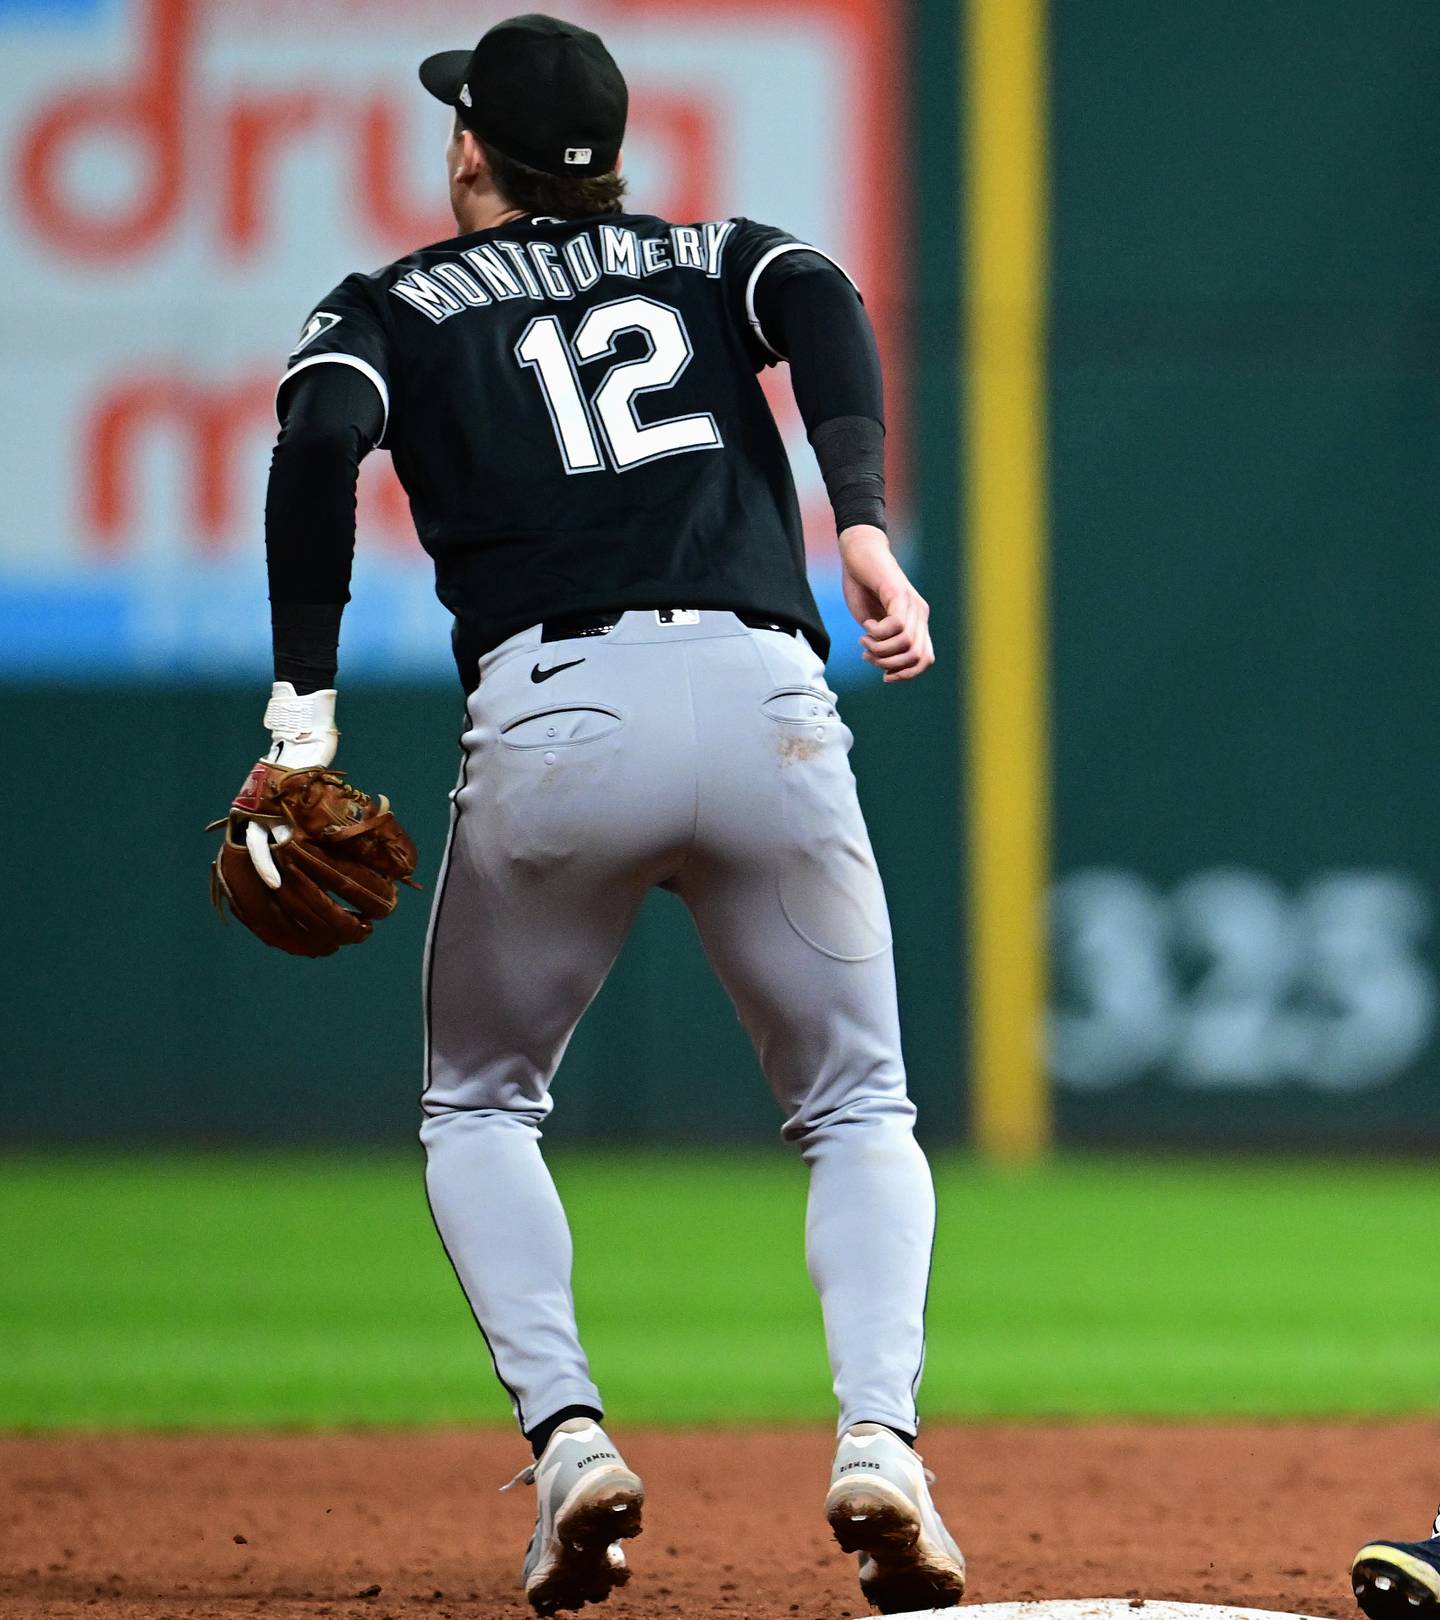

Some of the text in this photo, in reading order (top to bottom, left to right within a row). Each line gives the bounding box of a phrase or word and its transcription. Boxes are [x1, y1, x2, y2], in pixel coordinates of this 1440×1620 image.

[389, 222, 736, 325] MONTGOMERY
[513, 294, 724, 475] 12
[1046, 868, 1438, 1092] 325
